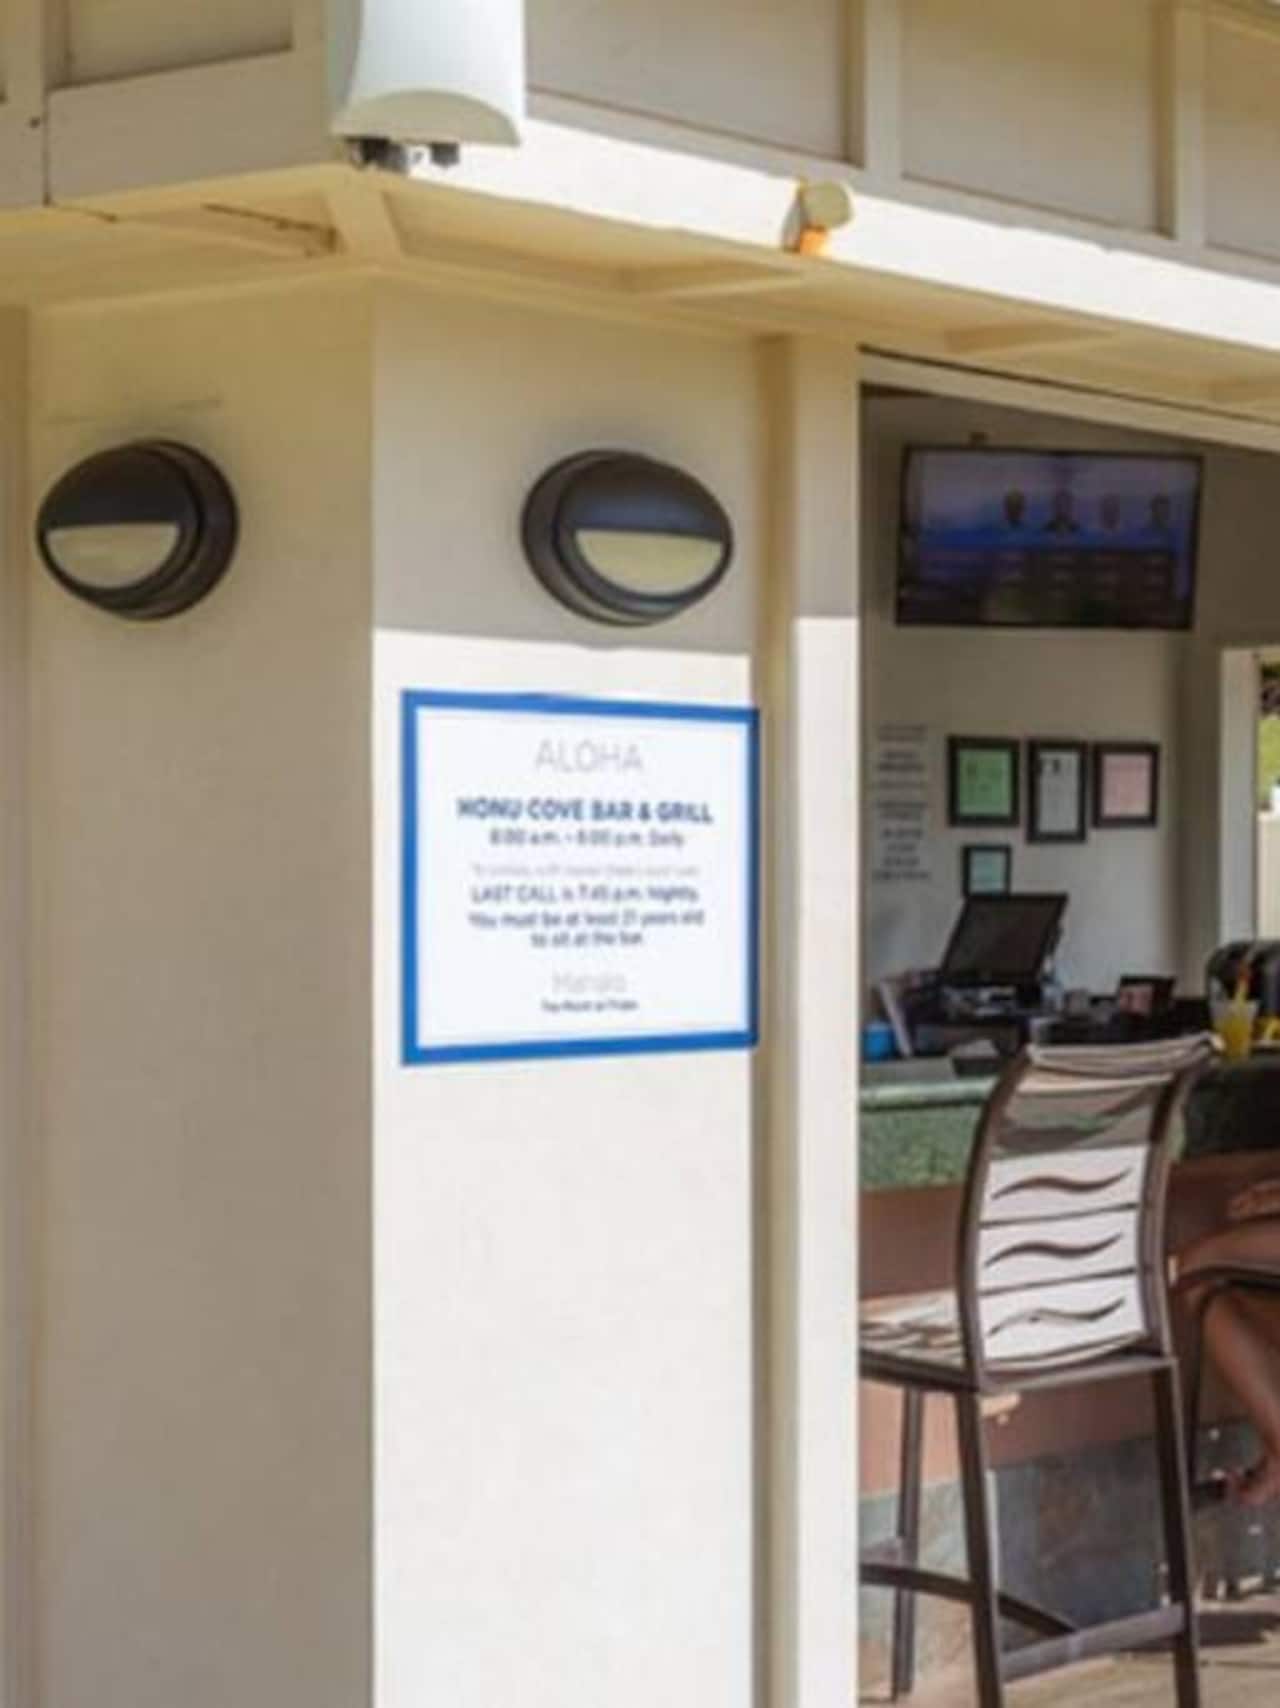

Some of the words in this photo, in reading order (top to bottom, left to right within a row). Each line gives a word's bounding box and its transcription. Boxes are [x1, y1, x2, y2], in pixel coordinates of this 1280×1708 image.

[535, 738, 645, 773] ALOHA
[526, 797, 584, 821] COVE
[591, 798, 634, 822] BAR
[638, 800, 651, 822] &
[656, 800, 714, 824] GRILL
[471, 884, 513, 903] LAST
[517, 884, 557, 903] CALL
